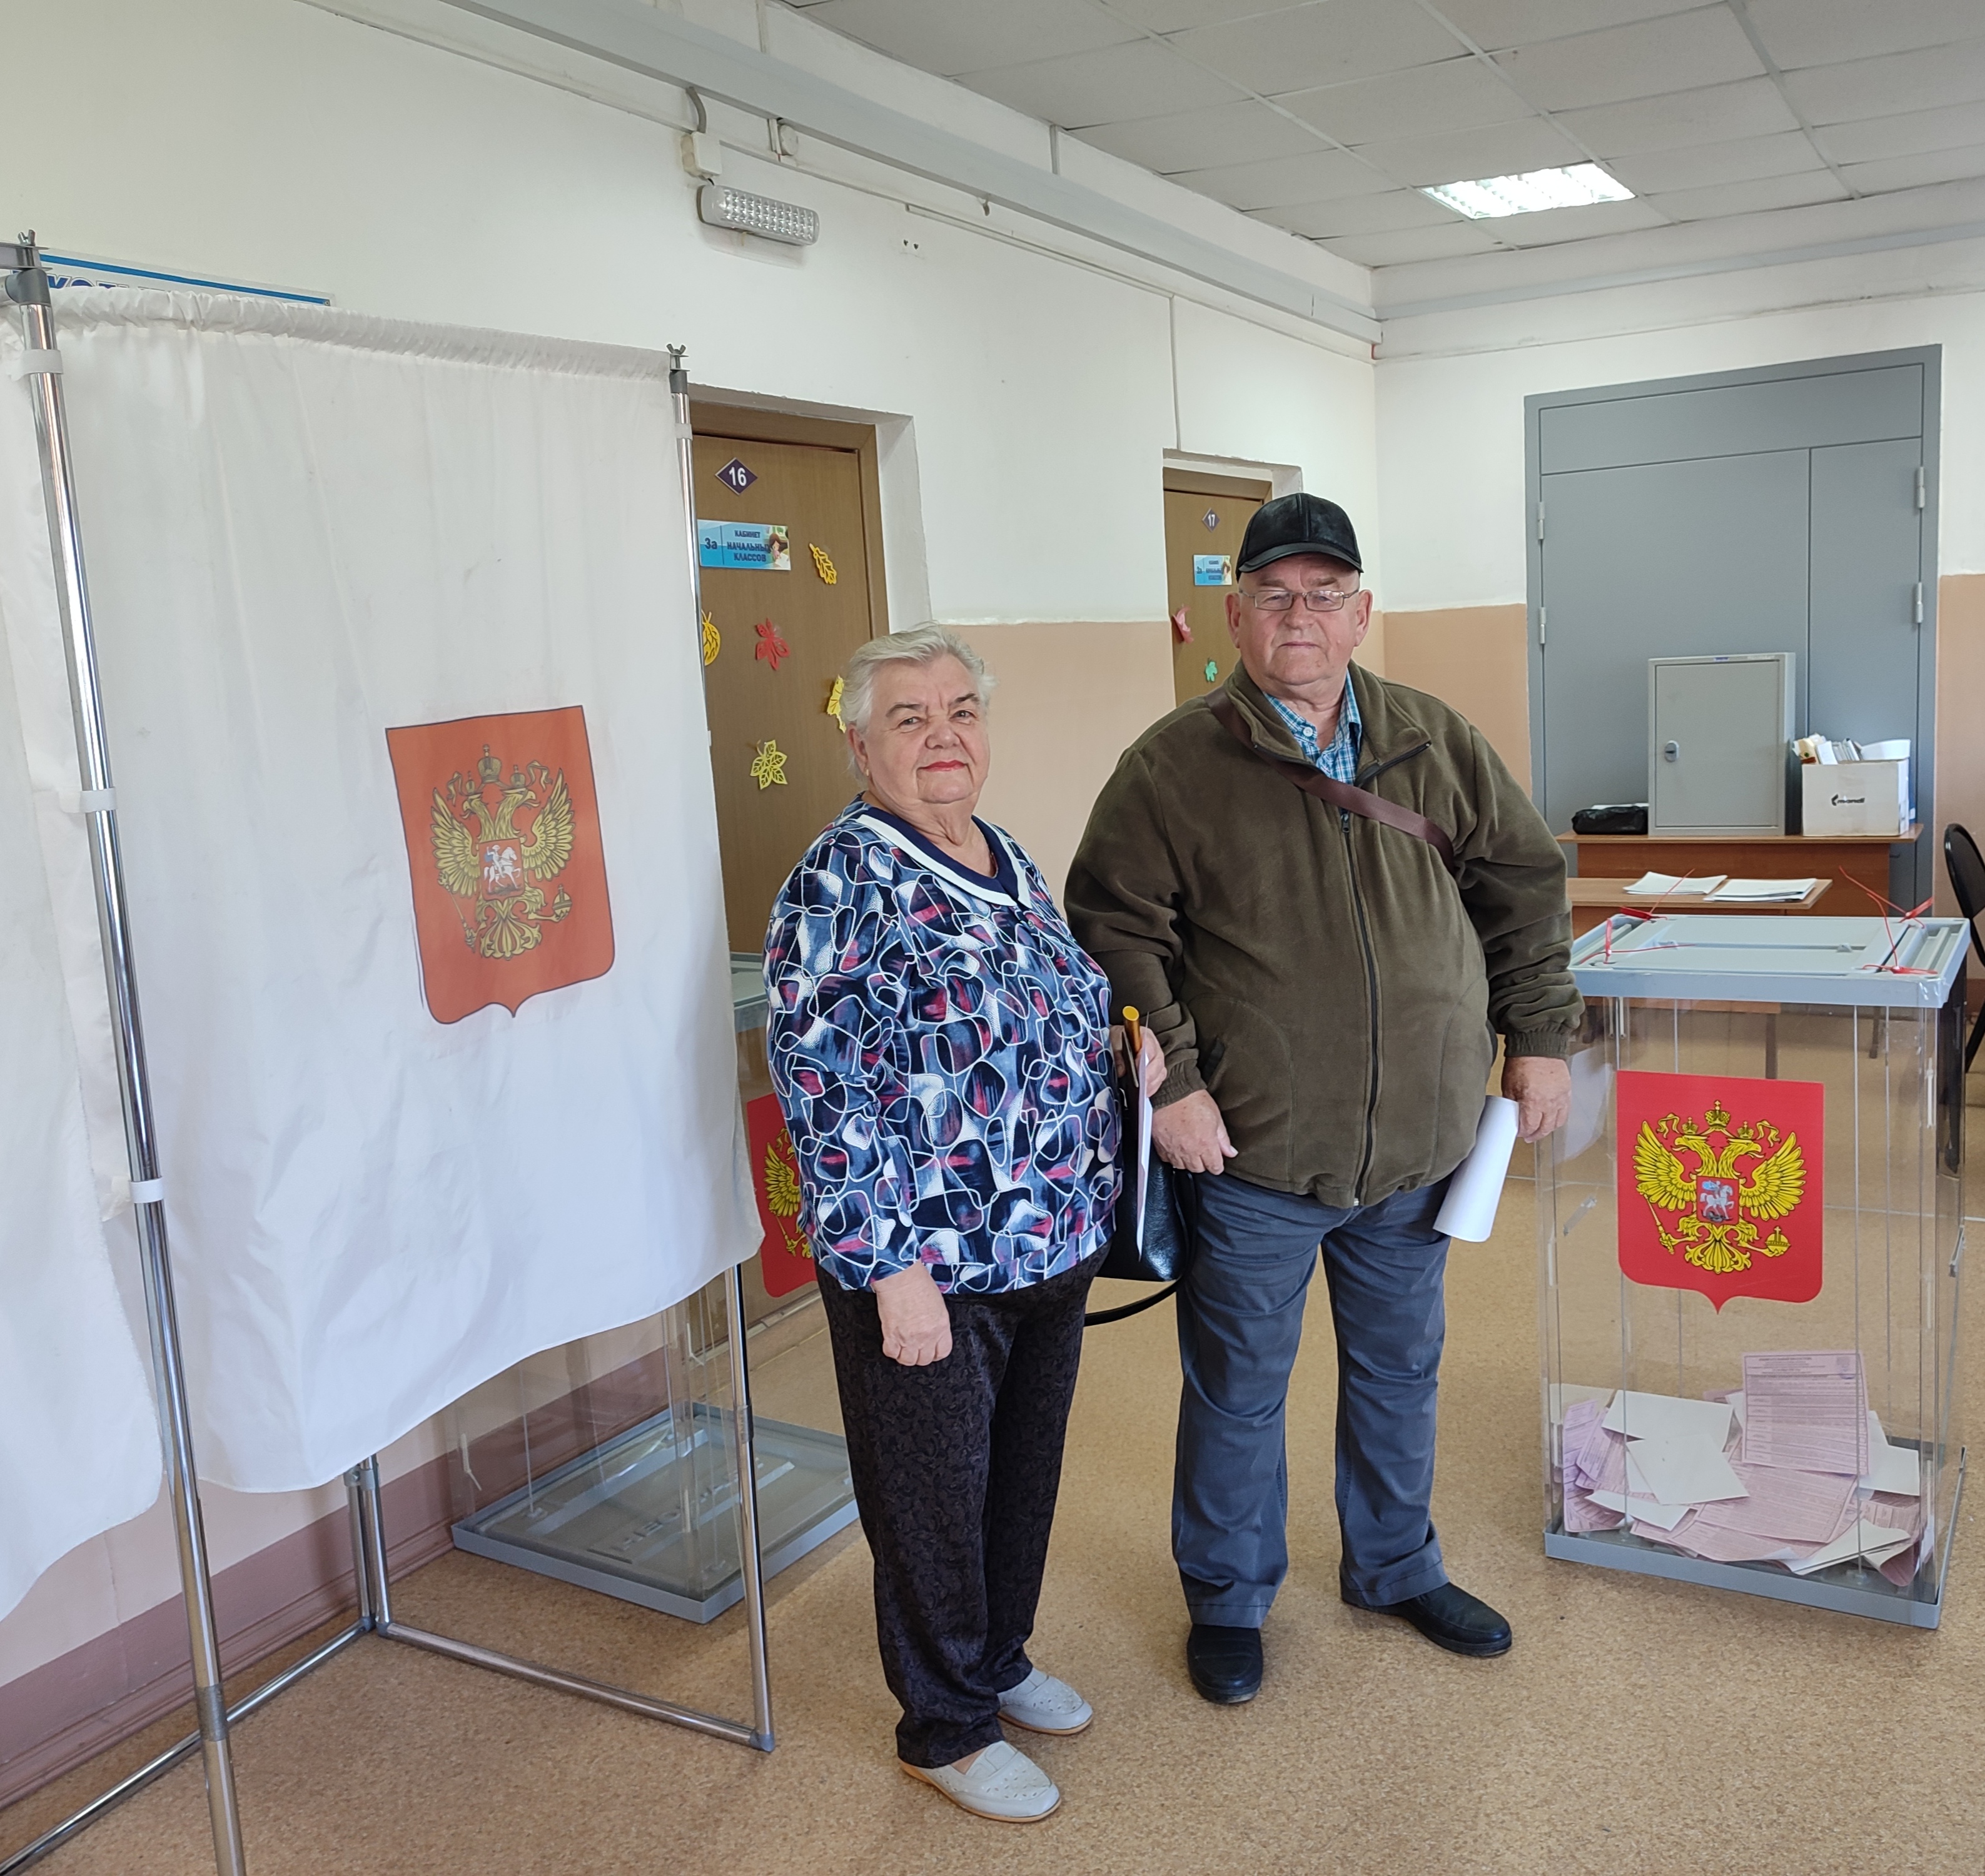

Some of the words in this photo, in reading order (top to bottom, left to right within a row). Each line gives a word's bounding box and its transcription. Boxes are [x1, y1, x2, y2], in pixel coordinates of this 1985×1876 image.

[729, 466, 747, 487] 16
[1208, 513, 1216, 527] 17
[734, 530, 760, 538] КАБИНЕТ
[734, 552, 767, 562] КЛАССОВ
